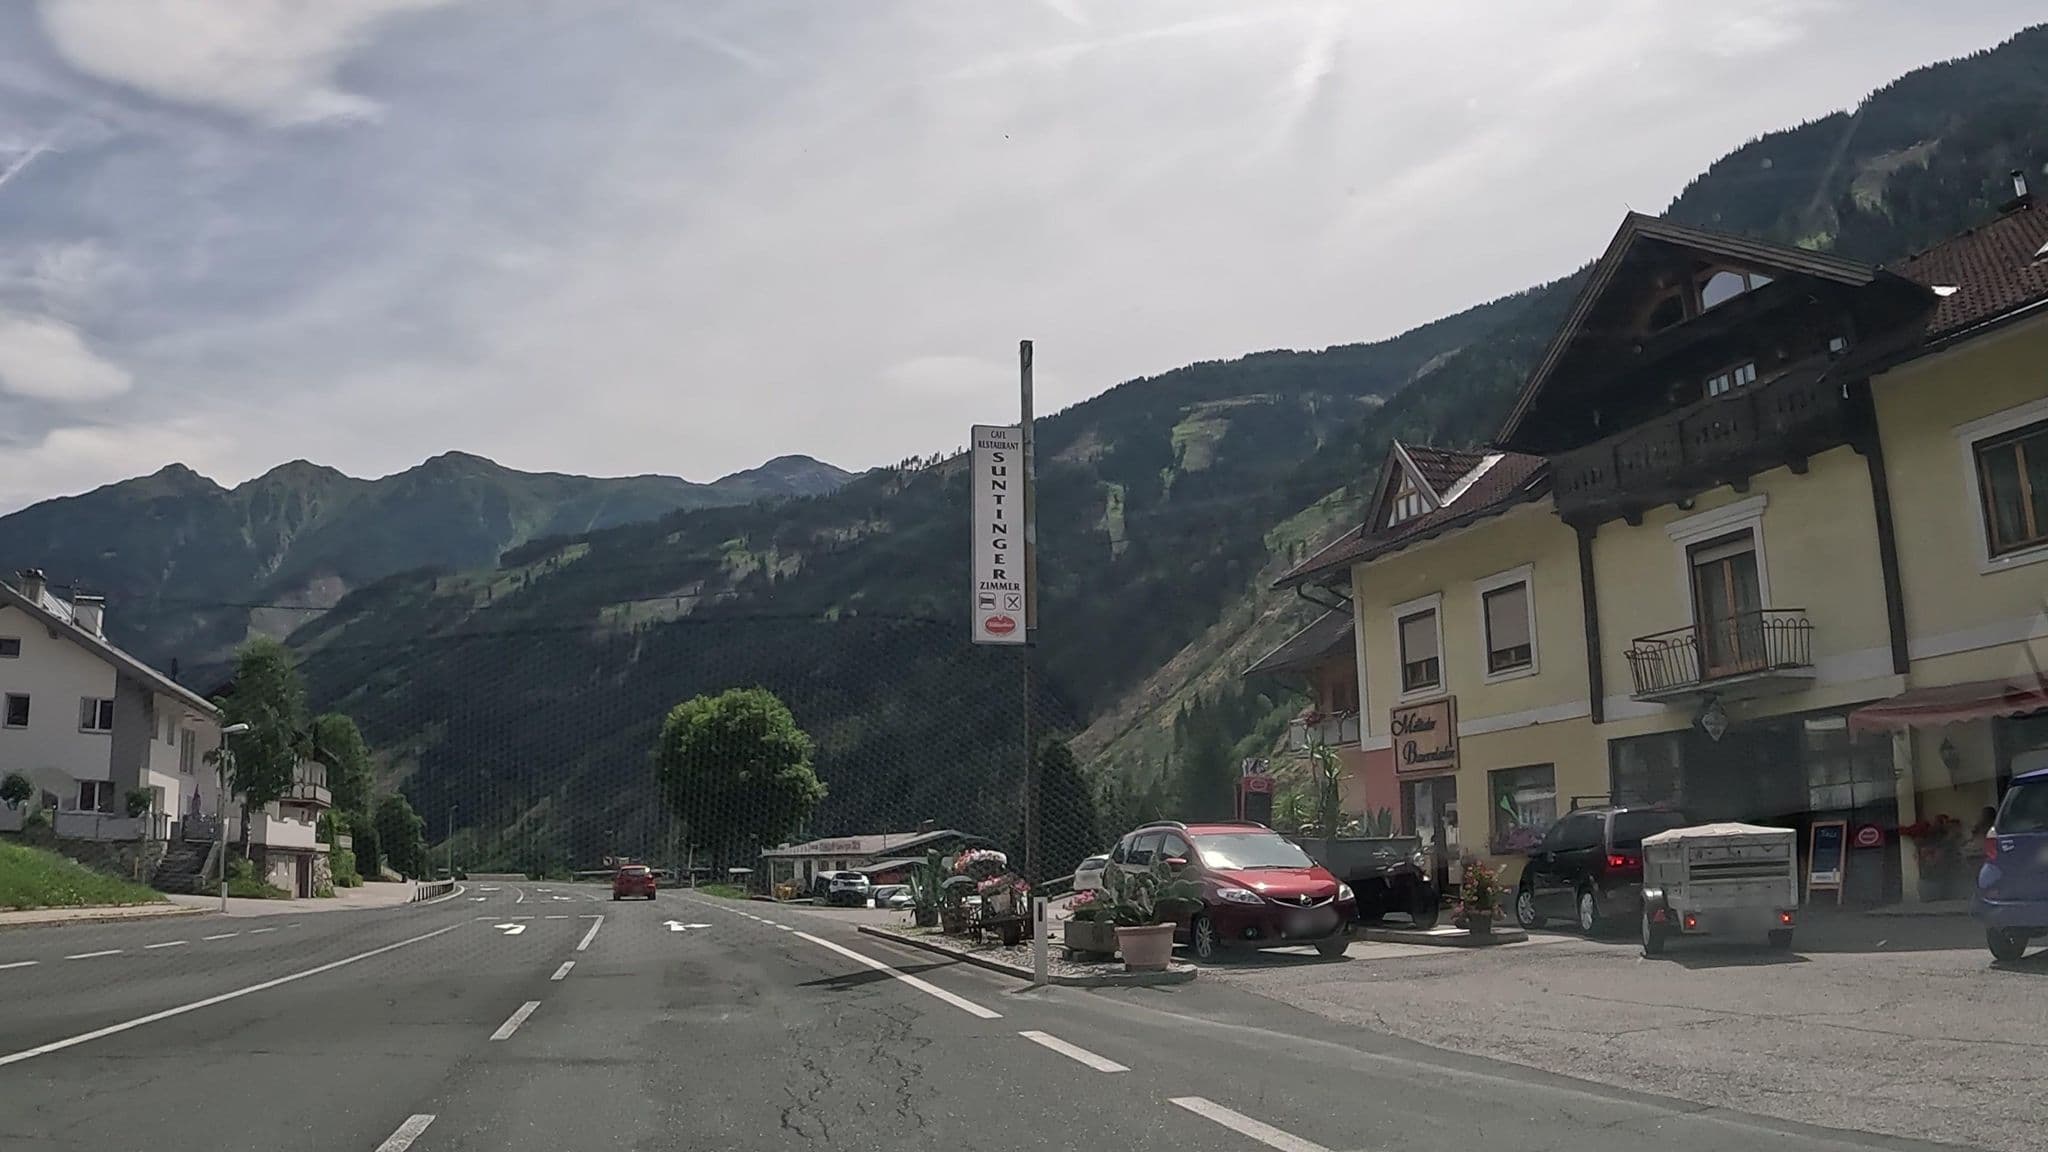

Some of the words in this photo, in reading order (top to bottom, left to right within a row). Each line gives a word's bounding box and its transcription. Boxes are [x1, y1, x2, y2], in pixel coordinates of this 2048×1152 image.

[977, 440, 1019, 450] RESTAURANT
[991, 452, 1008, 580] SUNTINGER
[979, 581, 1021, 591] ZIMMER
